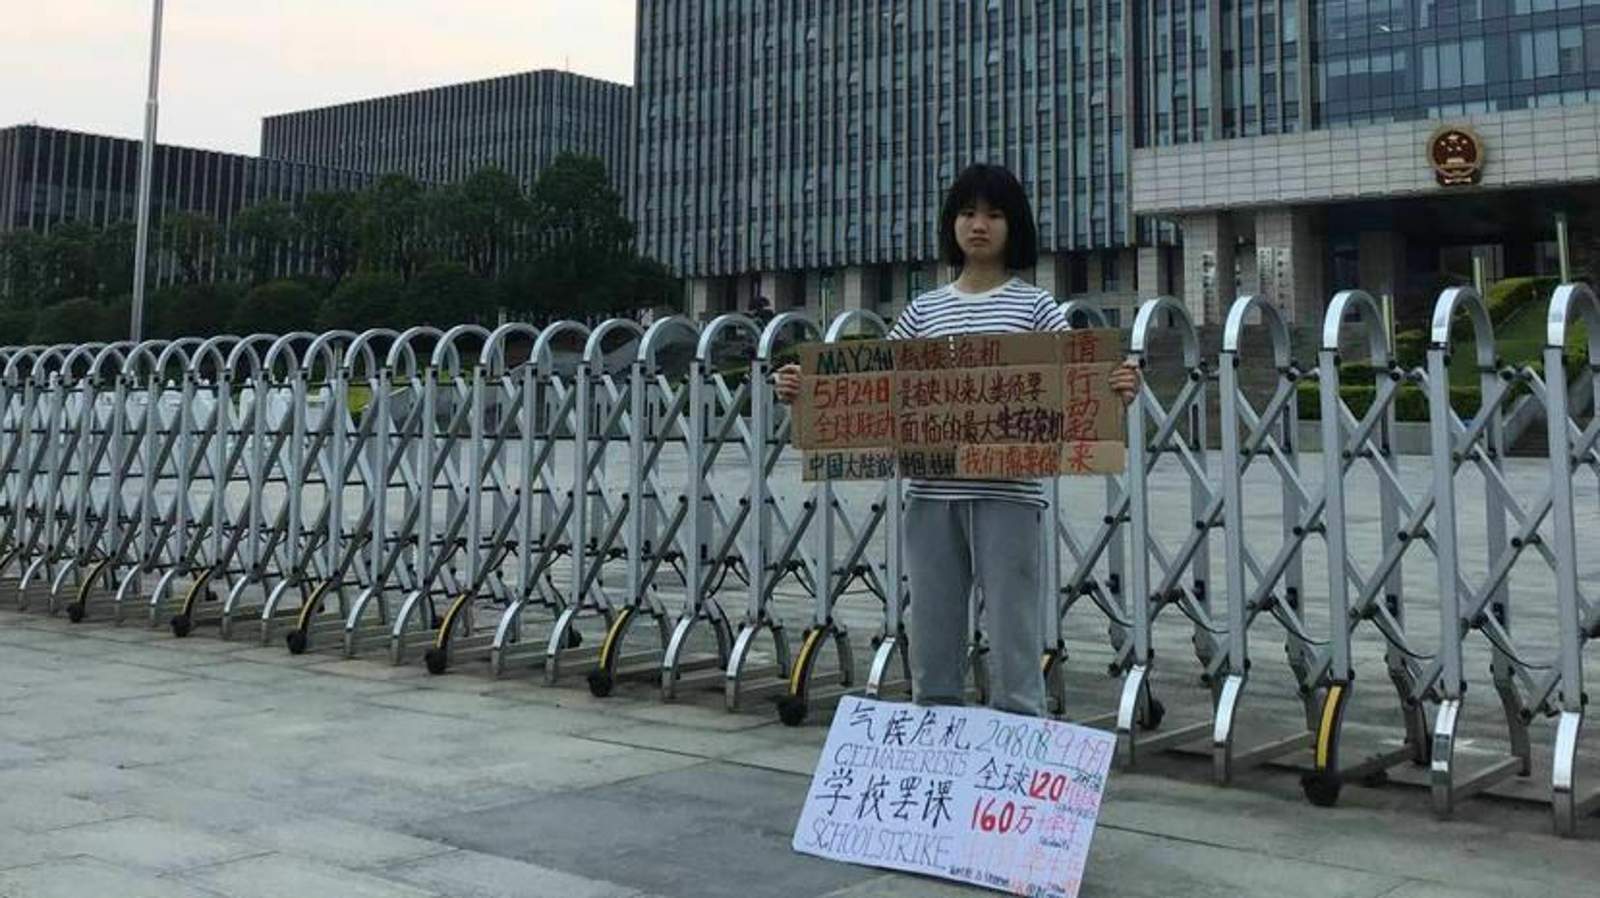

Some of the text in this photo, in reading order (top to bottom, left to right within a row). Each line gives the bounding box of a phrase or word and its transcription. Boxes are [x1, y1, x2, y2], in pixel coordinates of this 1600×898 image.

[813, 376, 890, 409] 5月24日
[849, 701, 971, 750] 气候危机
[814, 768, 954, 829] 学校罢课
